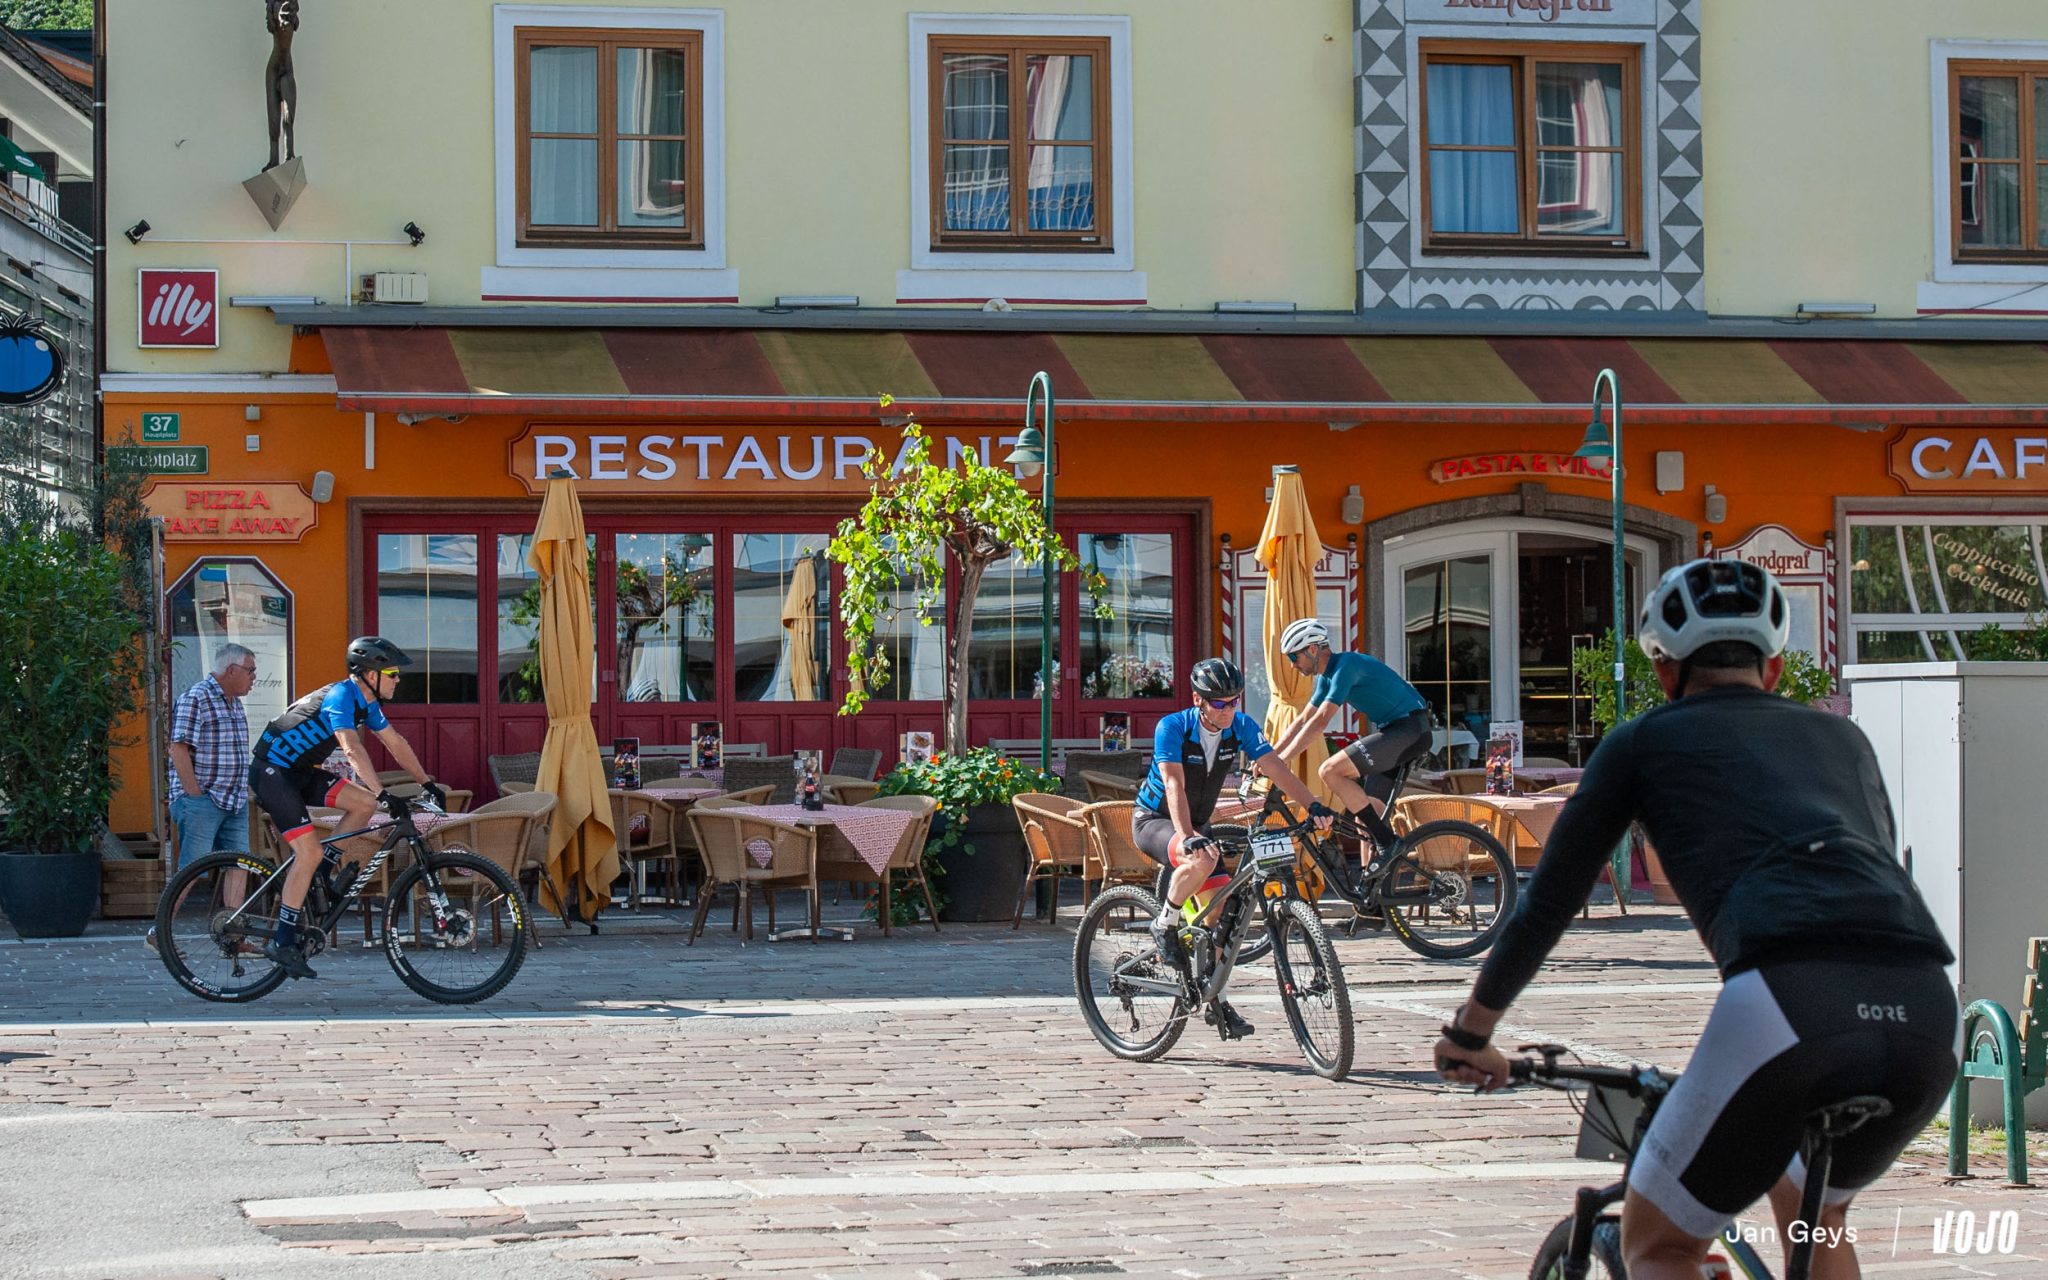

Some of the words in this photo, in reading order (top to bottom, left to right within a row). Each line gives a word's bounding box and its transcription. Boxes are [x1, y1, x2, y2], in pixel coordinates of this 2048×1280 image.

[148, 282, 212, 337] illy
[150, 416, 173, 432] 37
[1442, 455, 1526, 480] PASTA
[1533, 454, 1548, 473] &
[185, 490, 270, 510] PIZZA
[228, 517, 299, 535] AWAY
[1933, 533, 2039, 587] Cappuccino
[1947, 563, 2031, 608] Cocktails
[1260, 841, 1285, 855] 771
[1857, 1003, 1908, 1022] GORE
